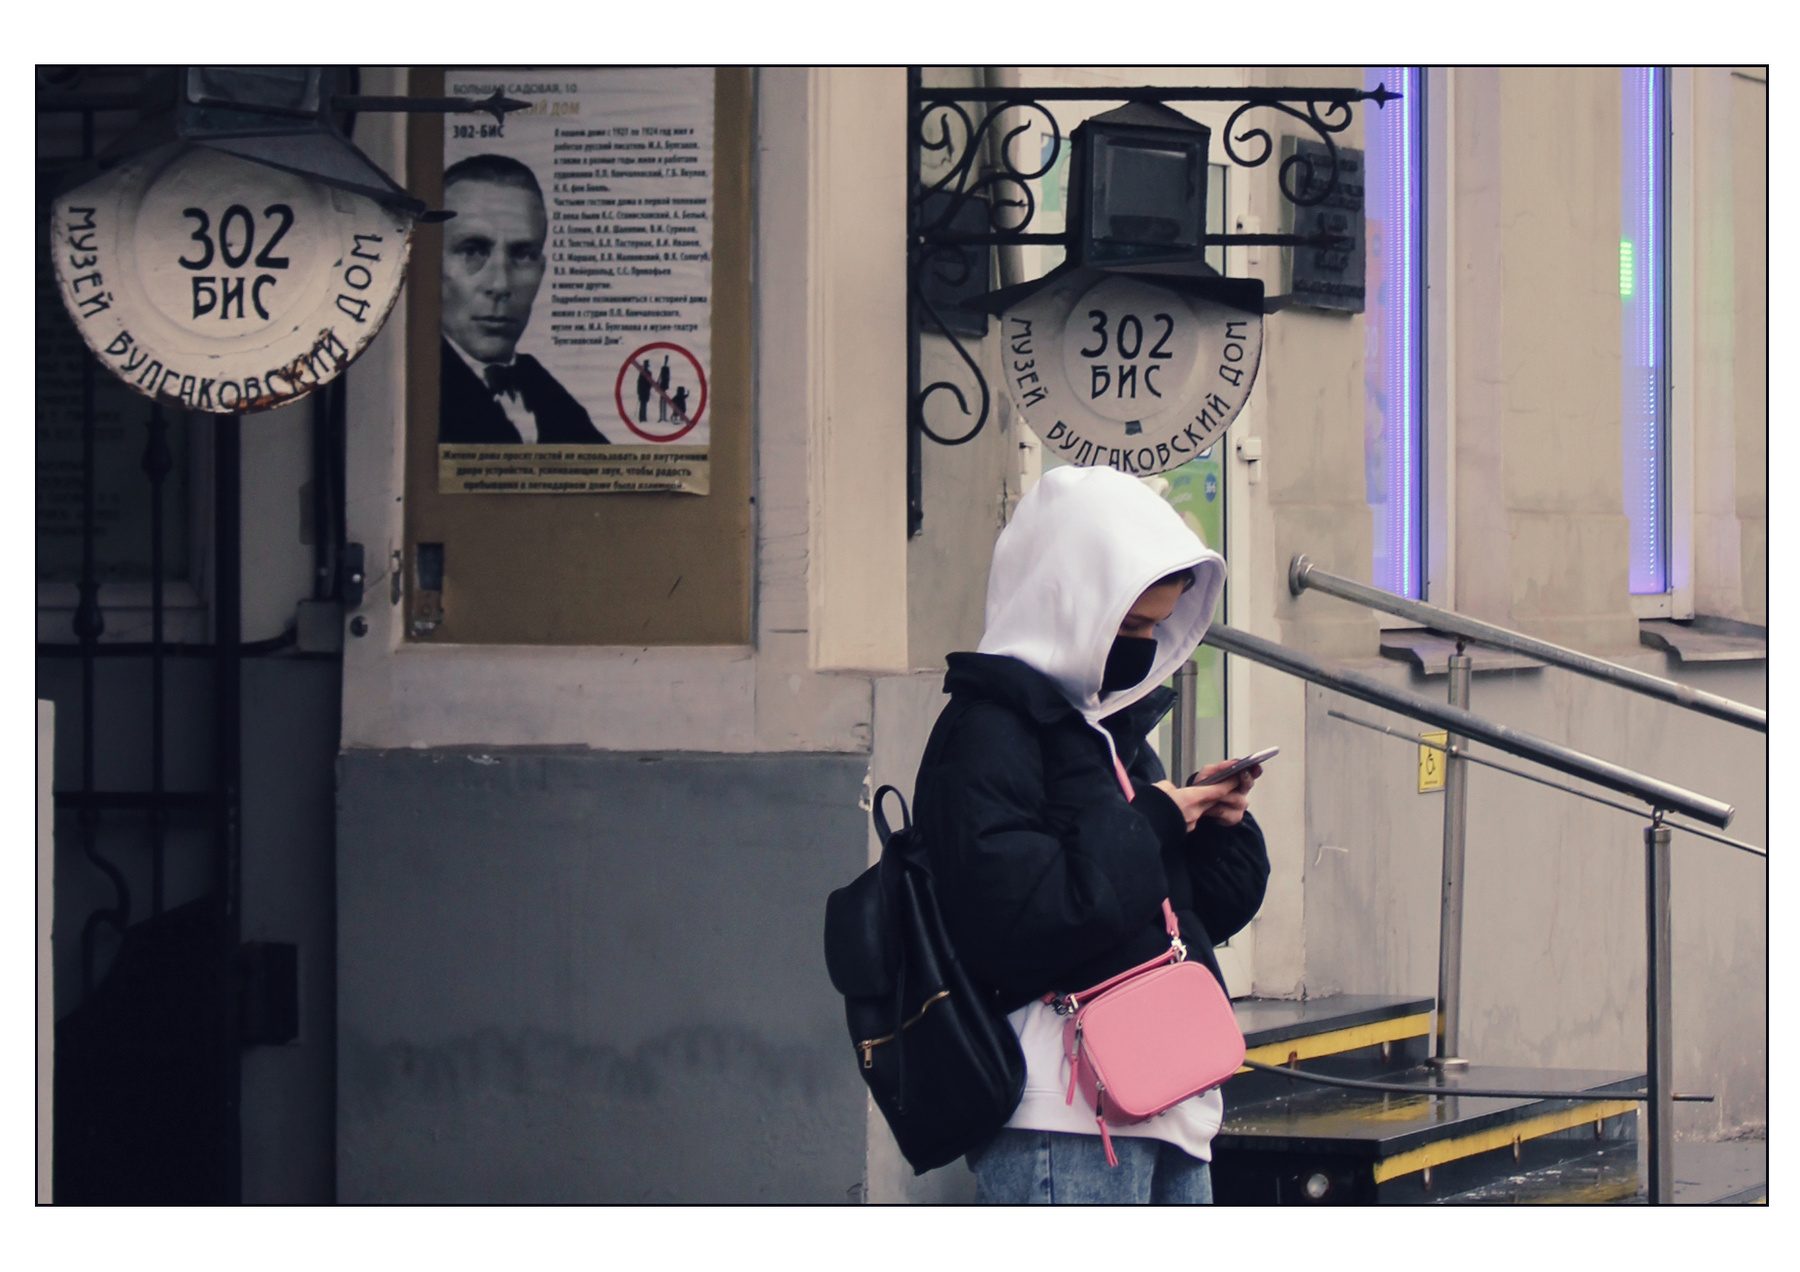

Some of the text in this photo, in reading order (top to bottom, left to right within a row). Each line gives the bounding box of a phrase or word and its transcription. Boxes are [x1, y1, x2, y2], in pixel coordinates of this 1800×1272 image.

[453, 125, 505, 138] 302-БИС
[551, 102, 580, 117] ДОМ
[178, 203, 294, 270] 302
[68, 206, 114, 318] МУЗЕЙ
[105, 326, 348, 409] БУЛГАКОВСКИЙ
[336, 234, 383, 322] ДОМ
[192, 274, 277, 320] БИС
[1080, 310, 1174, 360] 302
[1010, 317, 1247, 474] МУЗЕЙ БУЛГАКОВСКИЙ ДОМ
[1091, 364, 1162, 400] БИС
